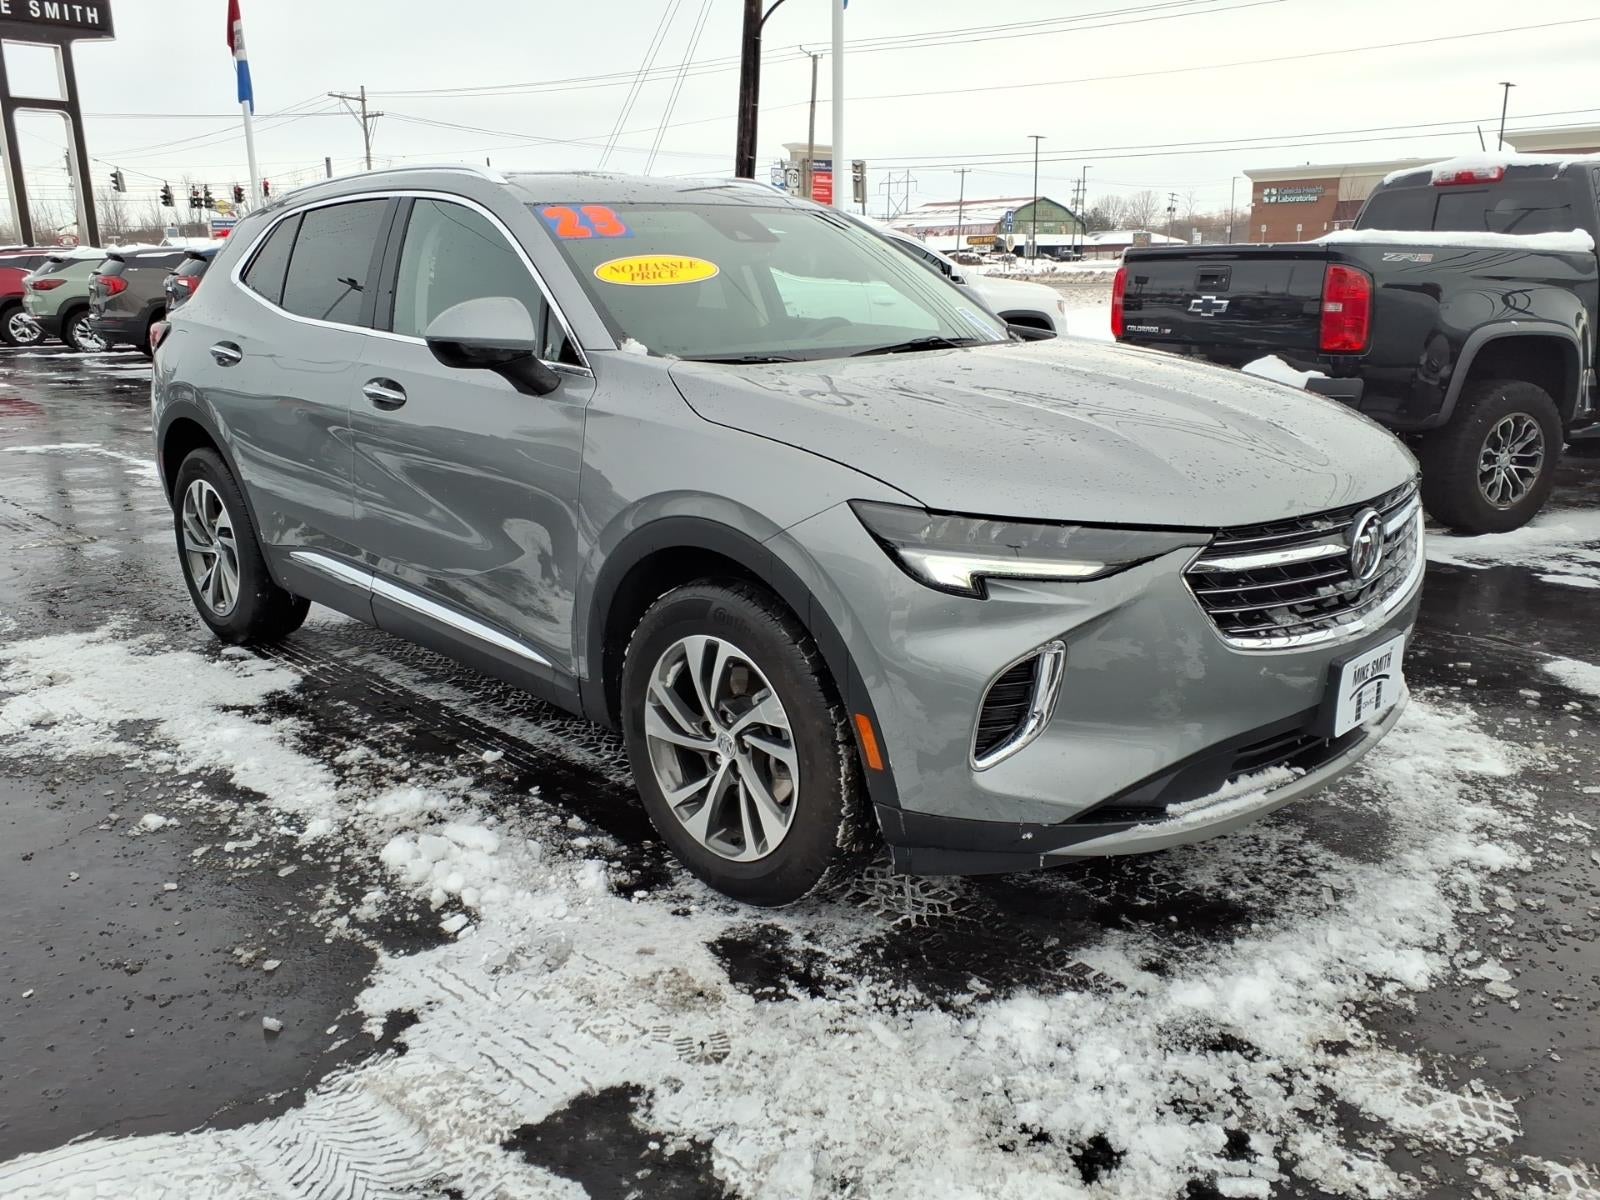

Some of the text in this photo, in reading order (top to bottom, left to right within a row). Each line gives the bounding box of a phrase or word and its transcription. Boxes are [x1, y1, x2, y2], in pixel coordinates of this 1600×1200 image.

[29, 0, 99, 24] SMITH
[788, 173, 797, 183] 78
[1278, 194, 1318, 203] Laboratories
[543, 206, 626, 239] 23
[610, 260, 698, 276] NO HASSLE
[631, 270, 679, 281] PRICE
[1126, 325, 1159, 333] COLORADO
[1352, 652, 1392, 687] MIKE SMITH
